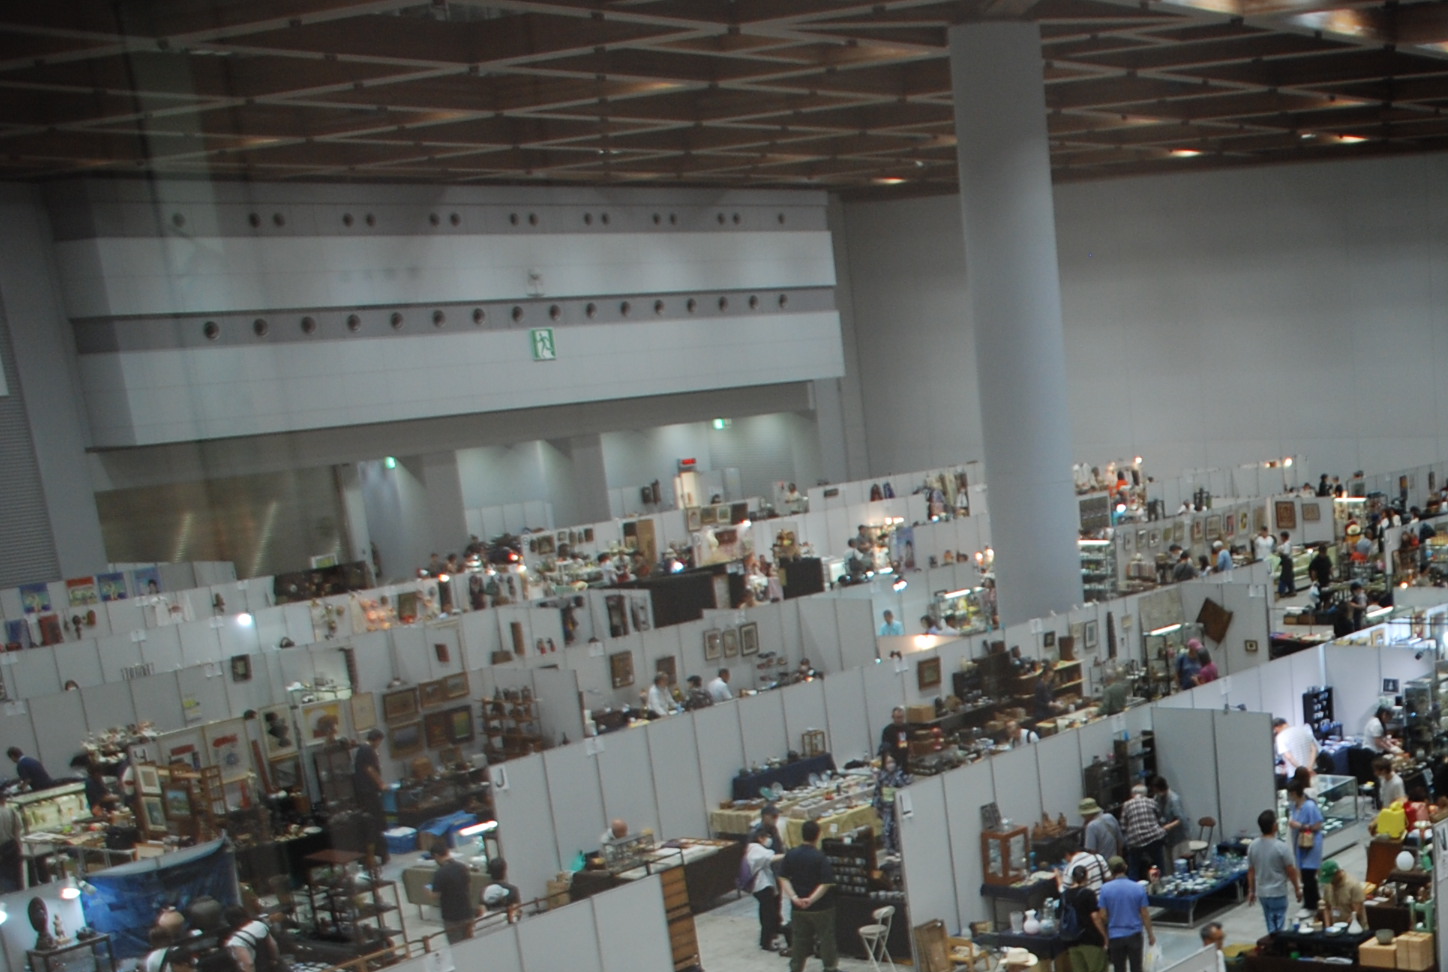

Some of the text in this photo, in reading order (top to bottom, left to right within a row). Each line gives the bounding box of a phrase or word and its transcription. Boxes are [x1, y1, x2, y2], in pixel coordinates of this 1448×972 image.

[495, 768, 505, 788] J
[899, 794, 912, 815] L
[1436, 827, 1448, 851] N
